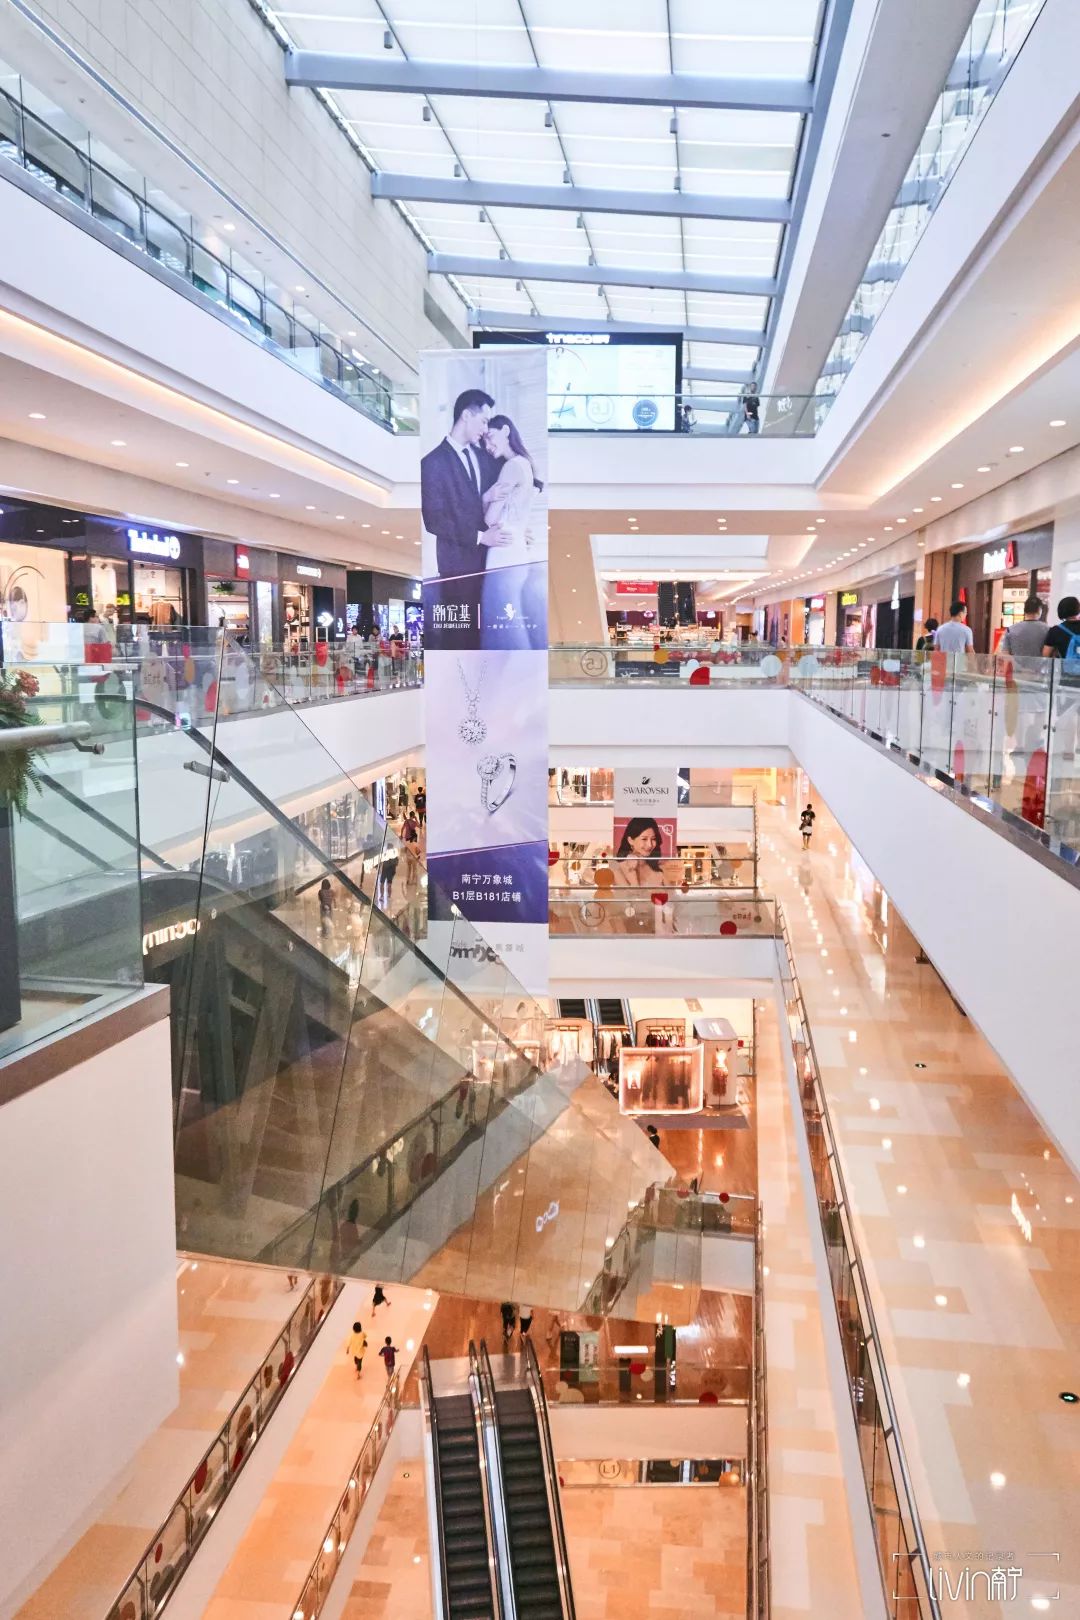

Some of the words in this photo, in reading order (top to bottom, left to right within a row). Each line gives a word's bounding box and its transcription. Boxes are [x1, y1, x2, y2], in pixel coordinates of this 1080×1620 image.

[432, 603, 471, 622] 潮宏基
[623, 786, 670, 795] SWAROVSKI
[461, 874, 513, 885] 南宁万象城
[452, 891, 522, 902] B1层B181店铺
[604, 1465, 616, 1474] L1
